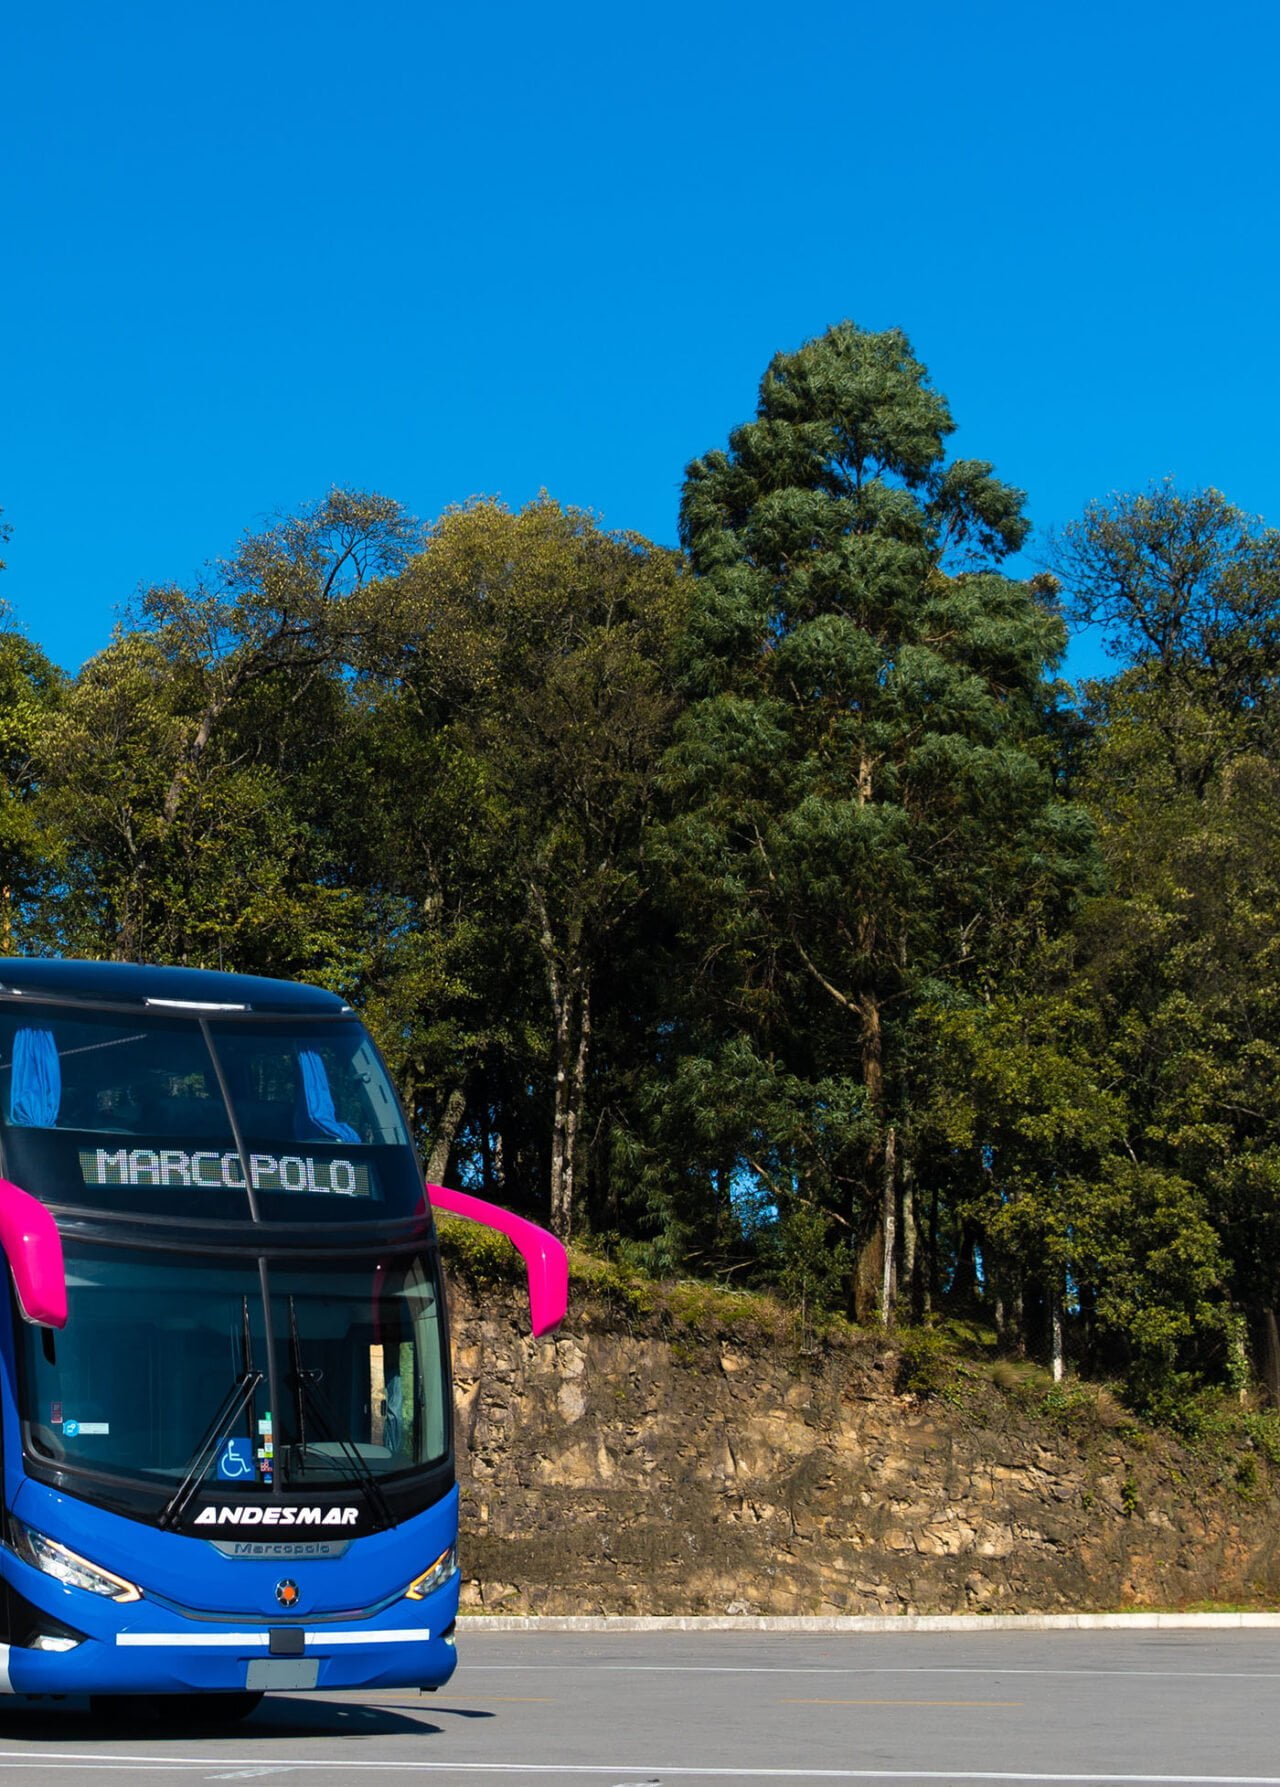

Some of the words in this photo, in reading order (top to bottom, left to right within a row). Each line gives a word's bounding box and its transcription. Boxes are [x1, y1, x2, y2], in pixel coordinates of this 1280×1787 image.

[96, 1149, 357, 1196] MARCOPOLO
[193, 1506, 359, 1525] ANDESMAR
[234, 1543, 330, 1555] Marcopolo
